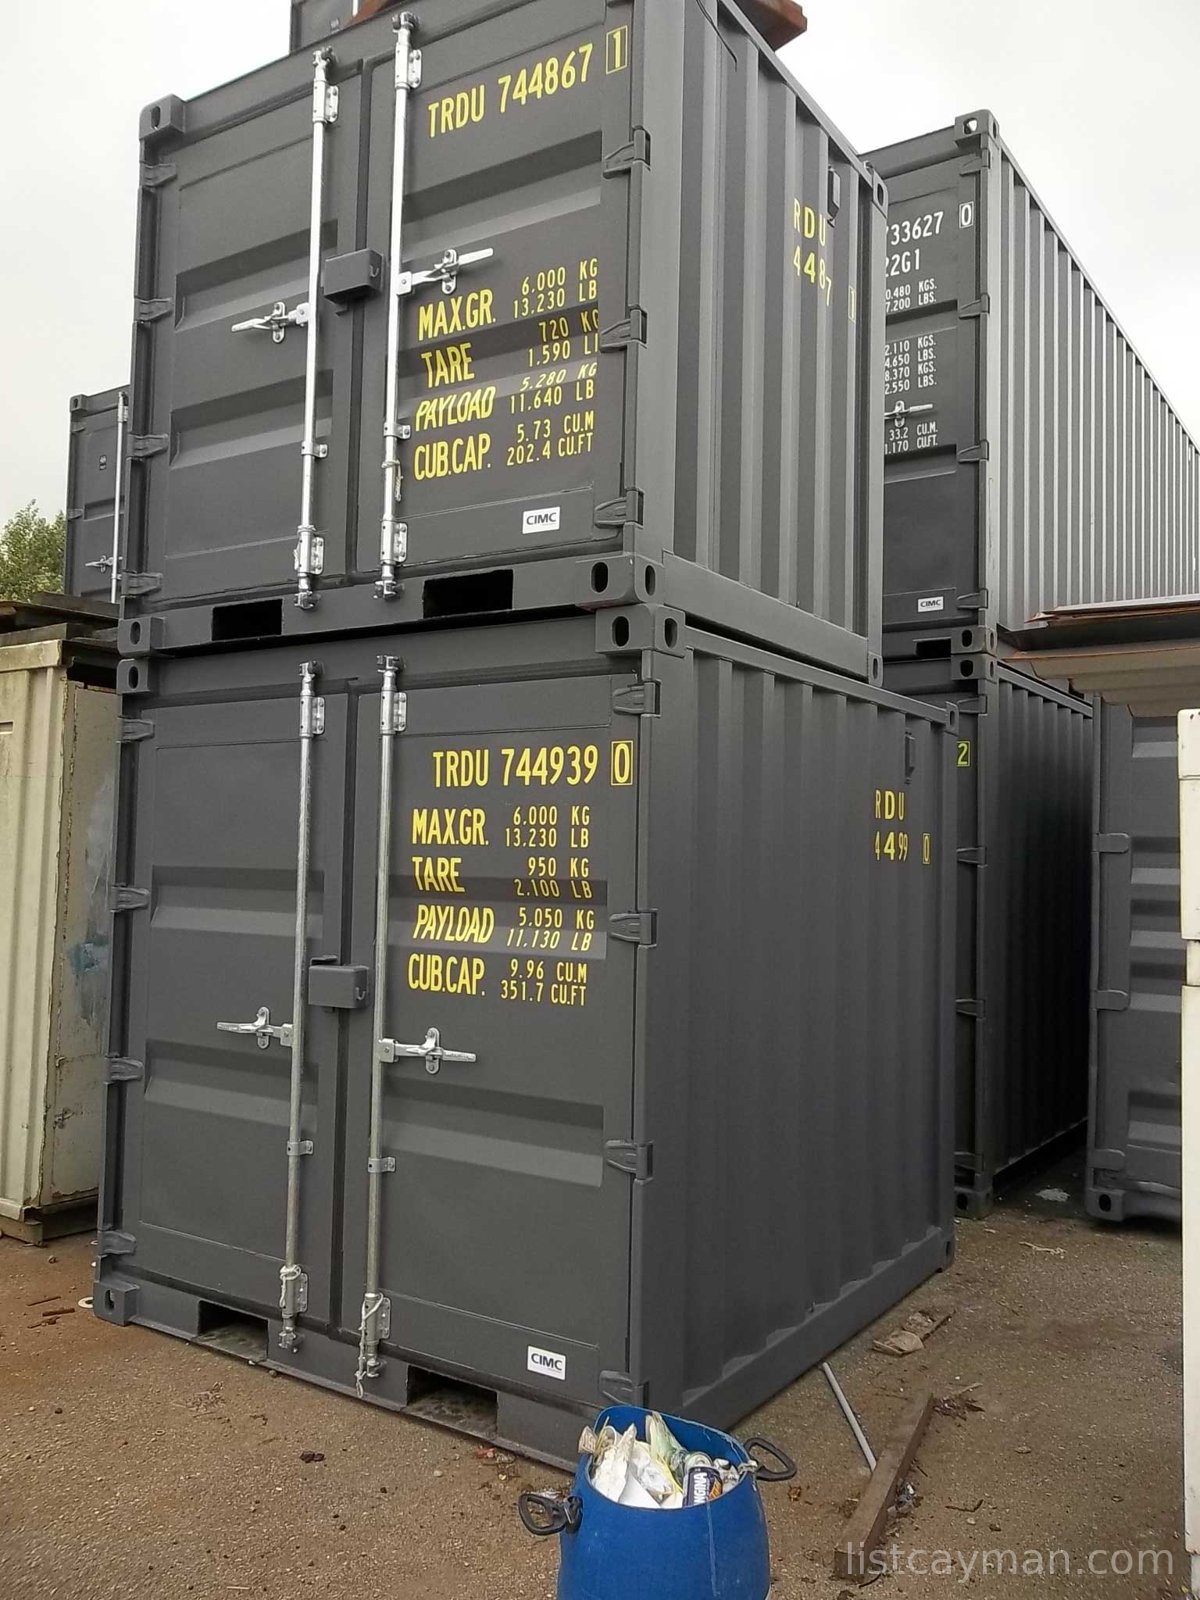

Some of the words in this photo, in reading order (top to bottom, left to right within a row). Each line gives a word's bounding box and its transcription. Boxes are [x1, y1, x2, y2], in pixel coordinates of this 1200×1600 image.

[428, 84, 485, 138] TRDU
[498, 43, 593, 112] 744867
[886, 211, 943, 245] 33627
[580, 258, 597, 280] KG
[579, 280, 596, 302] LB
[419, 289, 496, 340] MAX.GR.
[539, 317, 568, 341] 720
[421, 342, 475, 388] TARE
[577, 363, 597, 379] KG
[576, 379, 594, 401] LB
[416, 386, 496, 431] PAYLOAD
[517, 419, 550, 443] 5.73
[564, 411, 594, 433] CU.M
[414, 433, 491, 480] CUB.CAP.
[507, 440, 550, 466] 202.4
[558, 432, 593, 456] CU.FT
[527, 512, 556, 525] CIMC
[433, 749, 489, 787] TRDU
[501, 745, 598, 786] 744939
[412, 809, 488, 845] MAX.GR.
[571, 806, 589, 825] KG
[571, 828, 589, 848] LB
[412, 857, 465, 892] TARE
[528, 857, 556, 876] 950
[570, 858, 589, 877] KG
[572, 881, 592, 898] LB
[413, 905, 494, 943] PAYLOAD
[577, 909, 594, 930] KG
[572, 932, 592, 951] LB
[408, 953, 485, 996] CUB.CAP.
[511, 959, 544, 979] 9.96
[557, 962, 587, 983] CU.M
[501, 980, 544, 1002] 351.7
[551, 984, 586, 1006] CU.FT
[531, 1353, 562, 1371] CIMC
